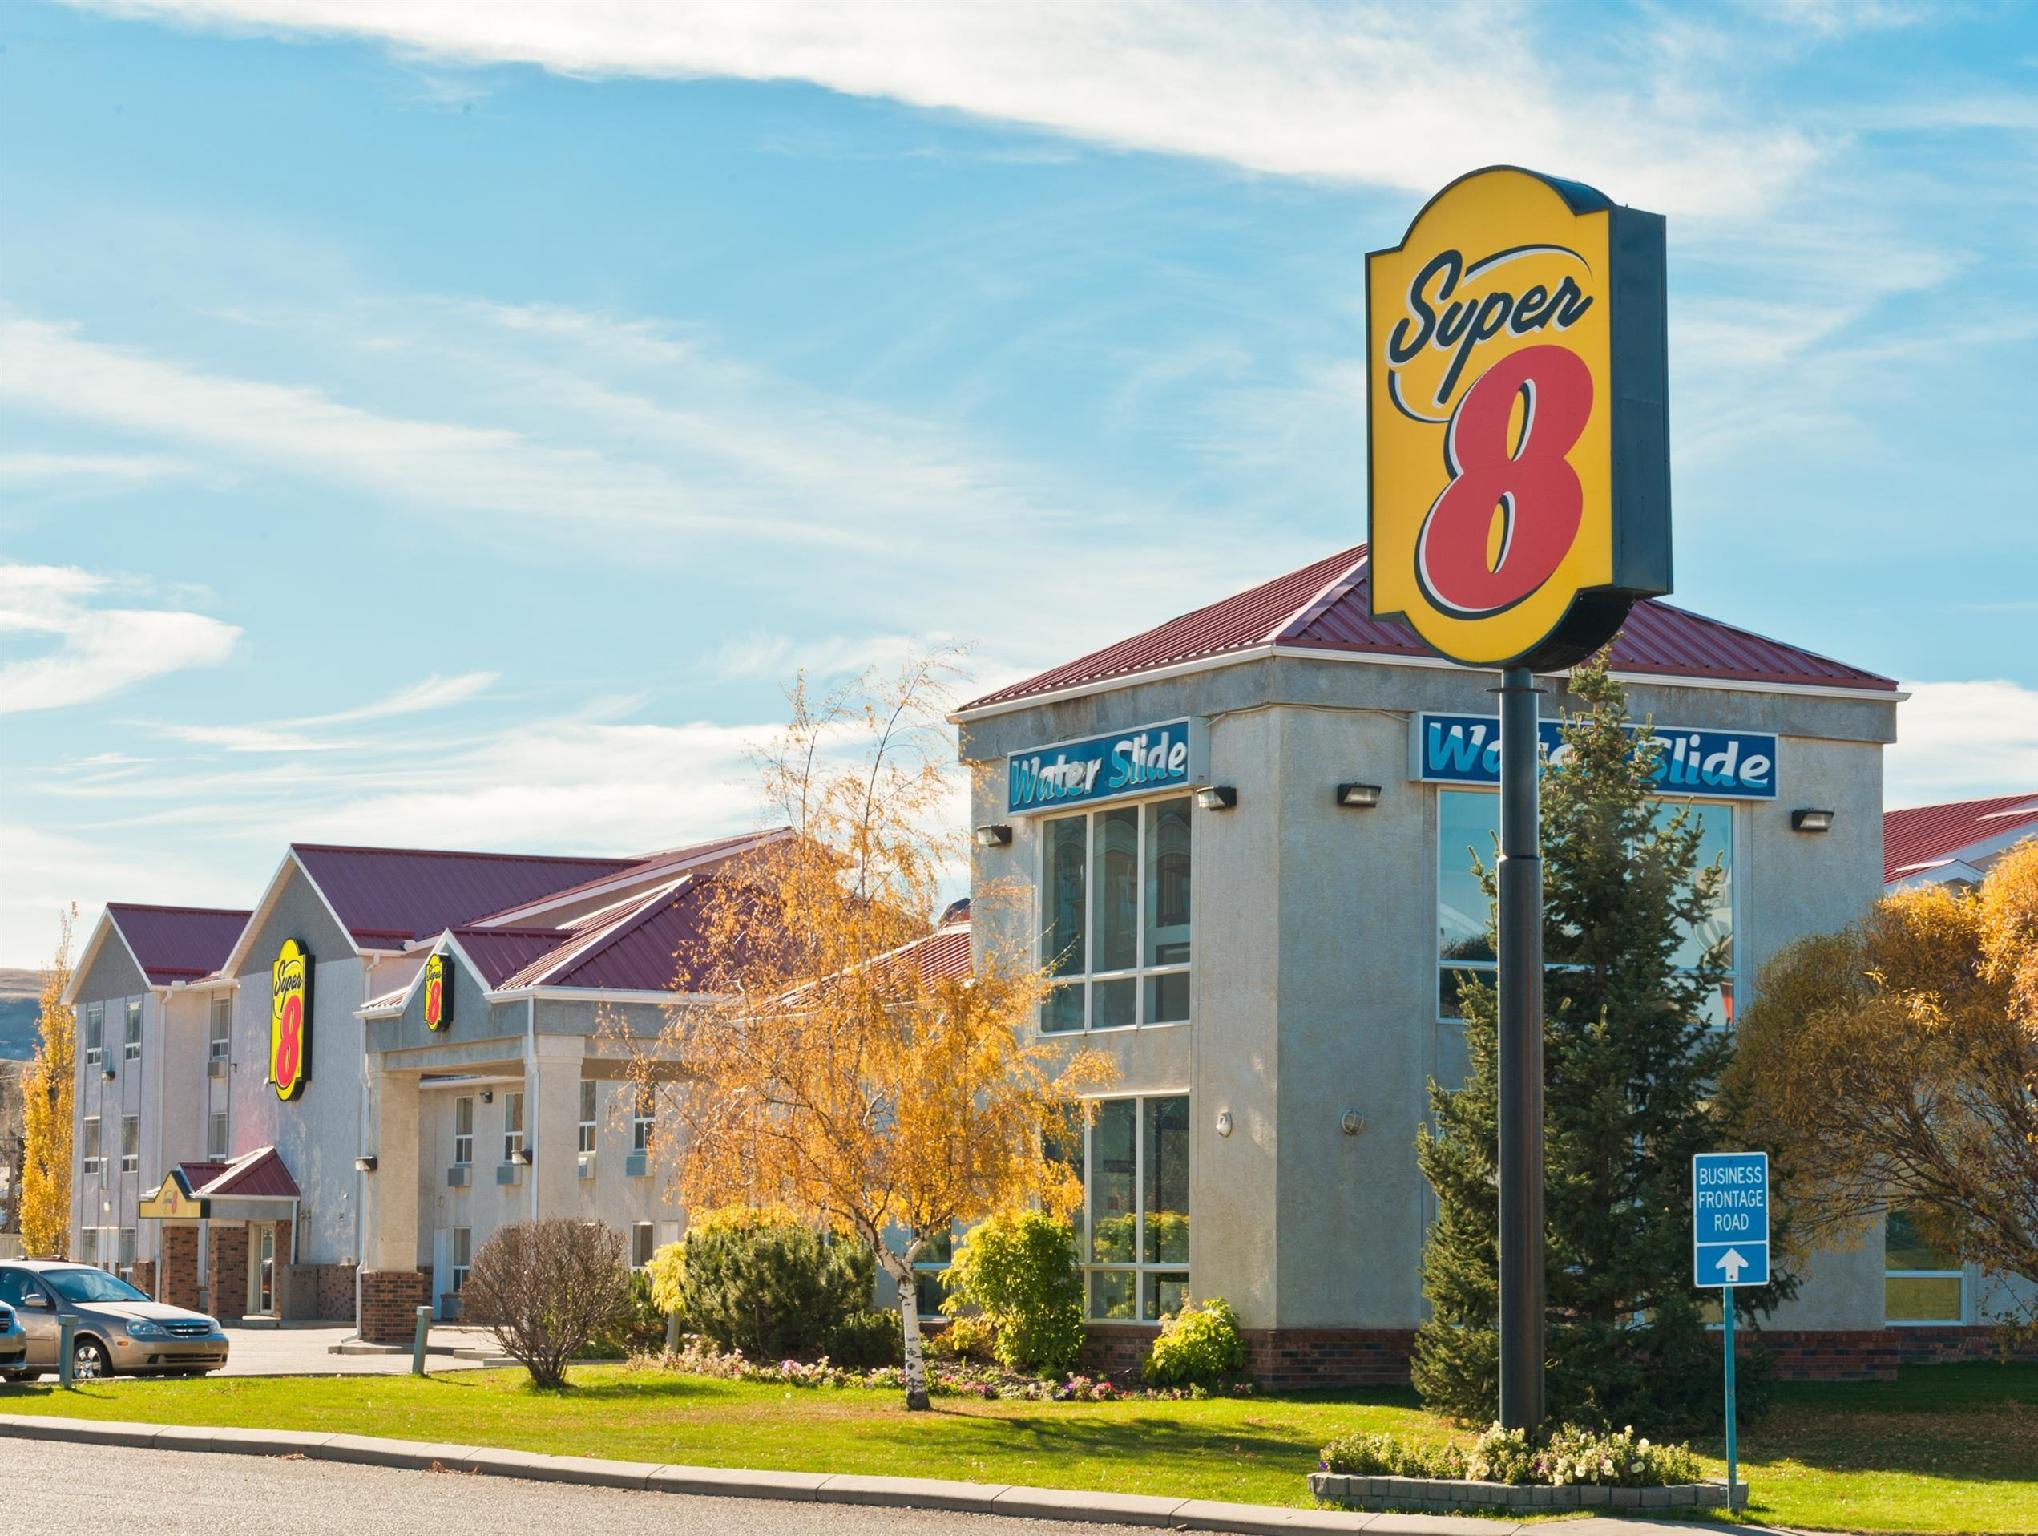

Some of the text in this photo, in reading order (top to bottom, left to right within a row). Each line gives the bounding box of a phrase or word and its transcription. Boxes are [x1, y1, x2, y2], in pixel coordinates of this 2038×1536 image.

[1384, 246, 1594, 408] Super
[1414, 344, 1594, 620] 8
[1010, 731, 1188, 807] Water Slide
[273, 959, 303, 1013] Super
[428, 980, 442, 1026] 8
[275, 994, 303, 1090] 8
[1698, 1189, 1764, 1208] FRONTAGE
[1699, 1166, 1763, 1185] BUSINESS
[1714, 1213, 1750, 1231] ROAD
